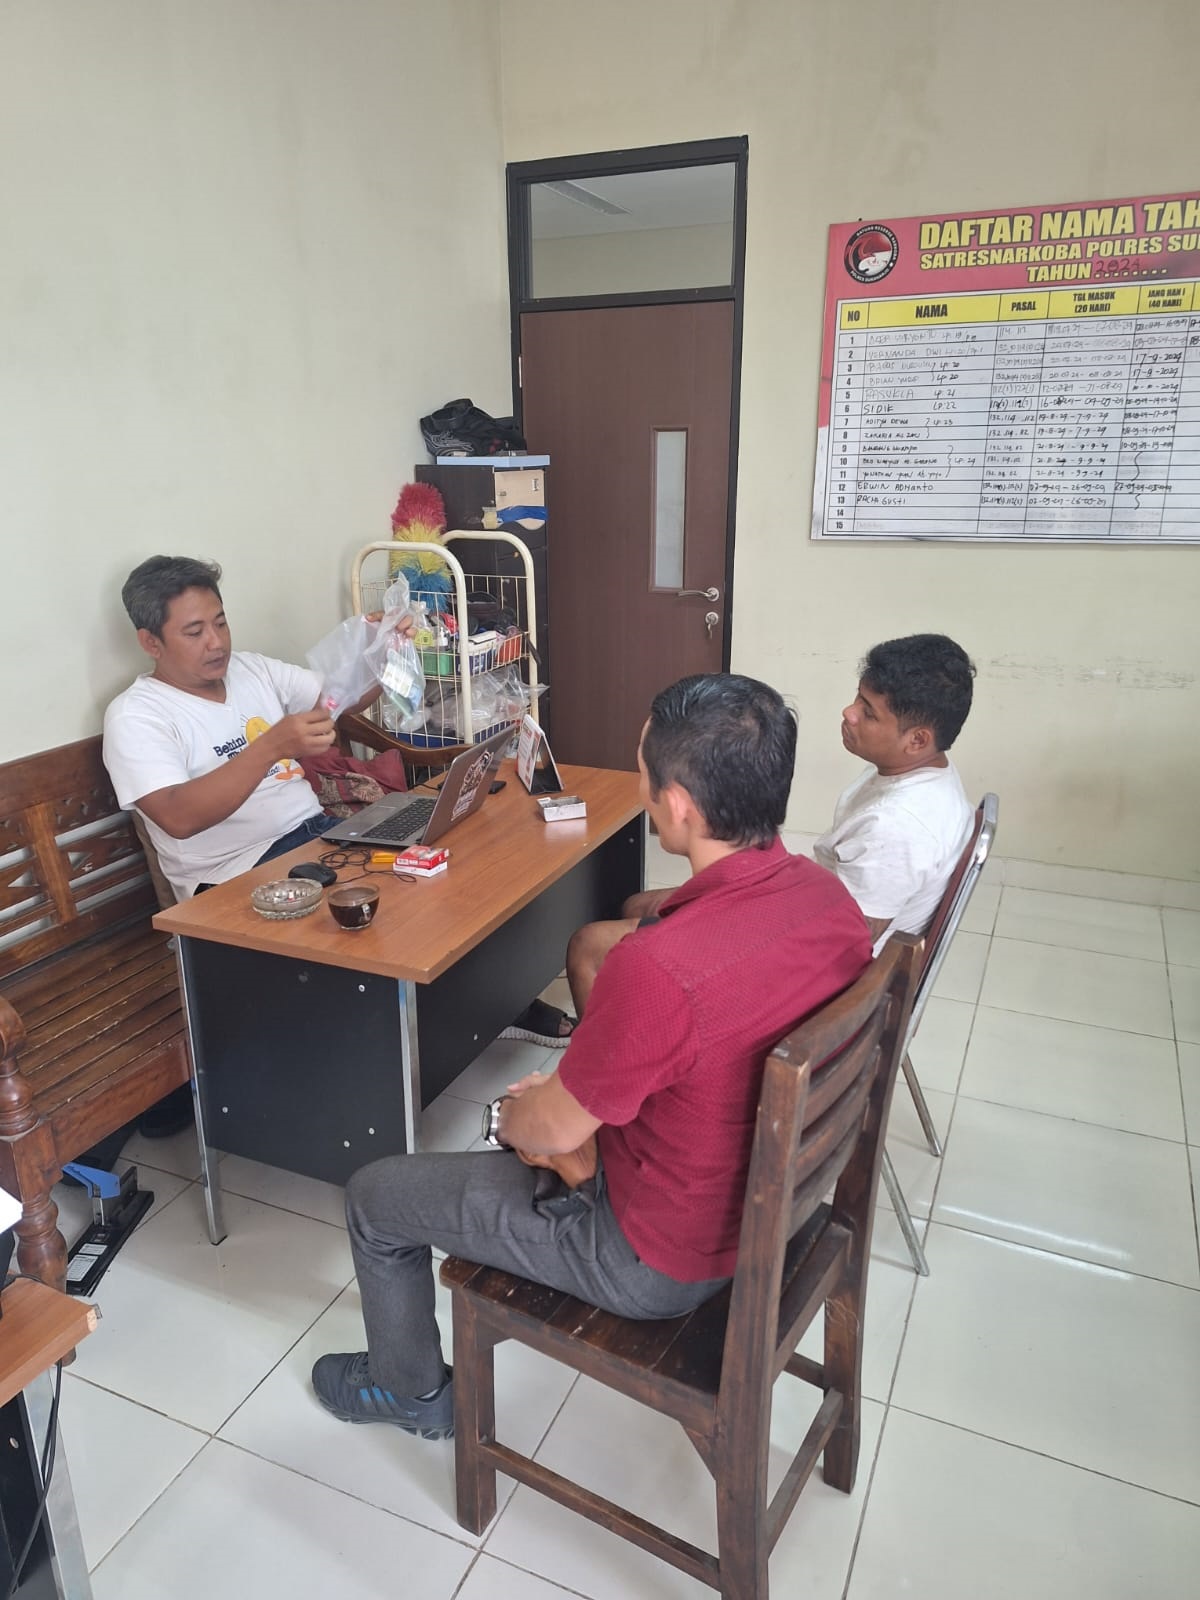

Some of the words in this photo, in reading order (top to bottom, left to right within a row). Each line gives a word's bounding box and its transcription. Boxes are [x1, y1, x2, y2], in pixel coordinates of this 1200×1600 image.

[919, 214, 1034, 251] DAFTAR
[1040, 204, 1136, 241] NAMA
[1143, 199, 1200, 232] TAH
[920, 242, 1083, 270] SATRESNARKOBA
[1085, 235, 1163, 259] POLRES
[1167, 233, 1200, 252] SU
[1073, 293, 1086, 302] TGL
[1087, 291, 1116, 301] MASUK
[915, 303, 948, 318] NAMA
[1011, 301, 1036, 312] PASAL
[847, 310, 861, 322] NO
[863, 403, 894, 415] SIDIK
